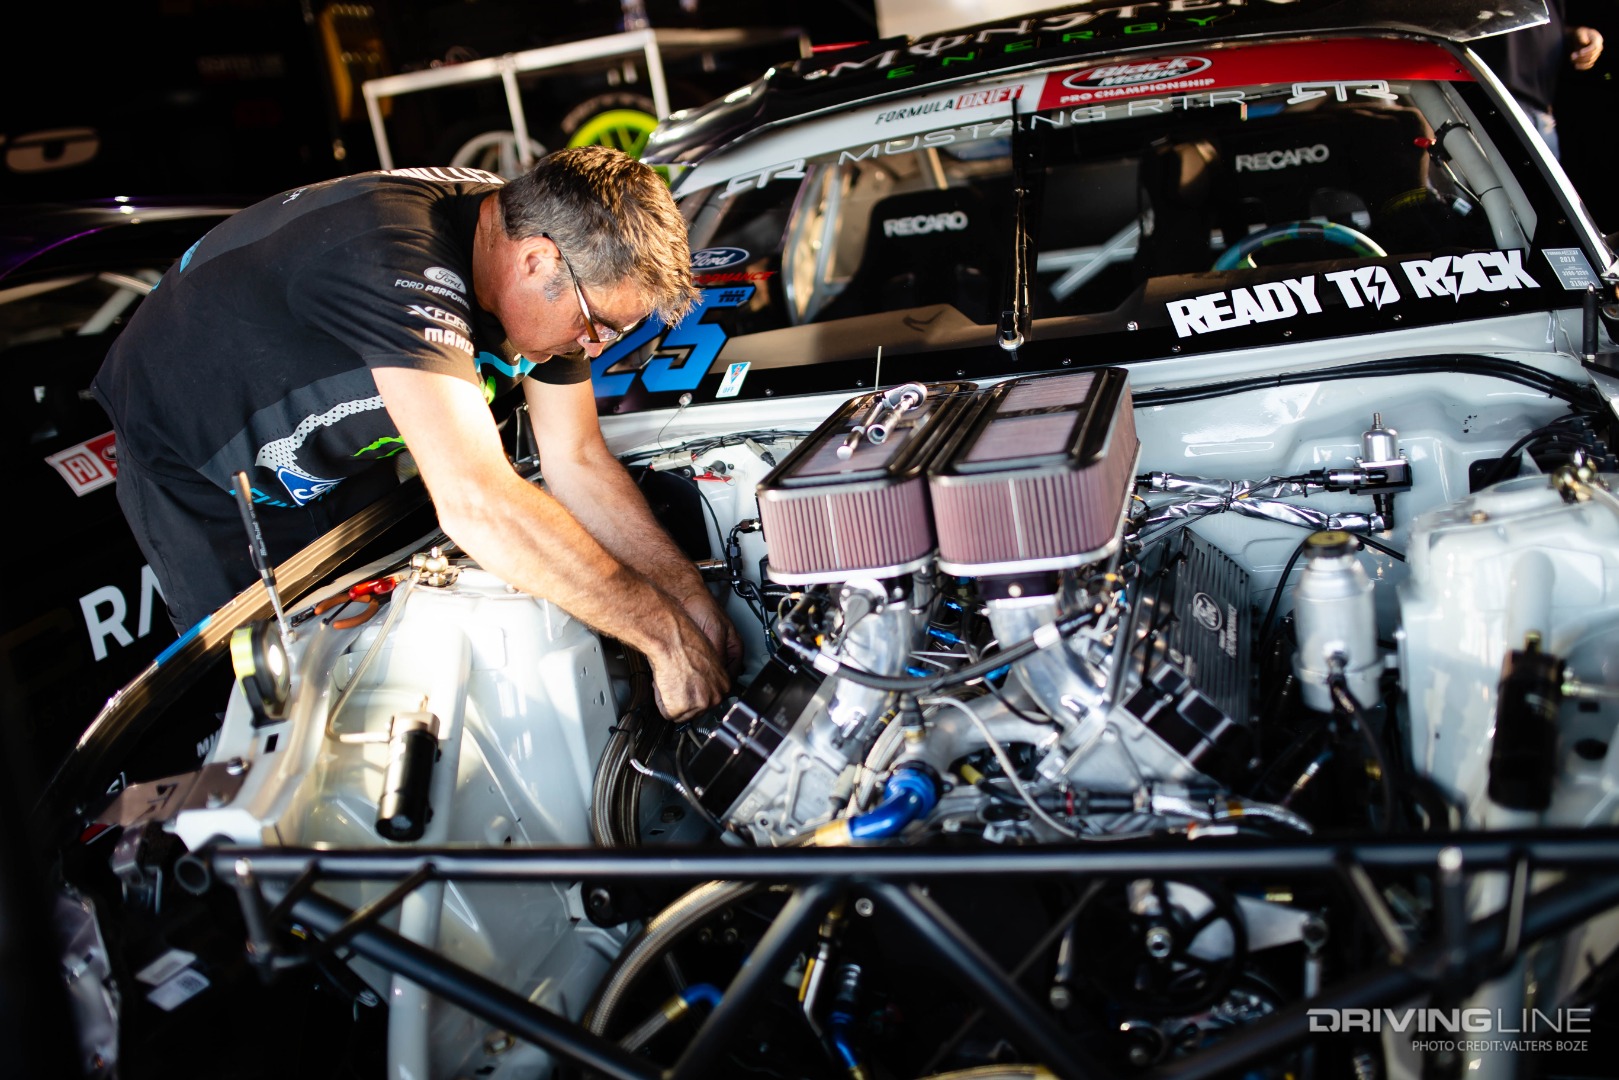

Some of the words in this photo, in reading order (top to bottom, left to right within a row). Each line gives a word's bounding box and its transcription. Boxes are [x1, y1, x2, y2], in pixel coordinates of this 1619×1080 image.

[1086, 57, 1192, 80] Black
[1060, 92, 1093, 104] PRO
[1093, 78, 1216, 99] CHAMPIONSHIP
[875, 99, 954, 124] FORMULA
[838, 106, 1108, 166] MUSTANG
[1129, 89, 1248, 118] RTR
[1235, 144, 1330, 172] RECARO
[883, 211, 969, 238] RECARO
[690, 250, 737, 268] Ford
[395, 278, 425, 290] FORD
[435, 269, 463, 291] Ford
[1165, 275, 1323, 338] READY
[1325, 265, 1400, 312] TO
[1400, 249, 1539, 304] ROCK
